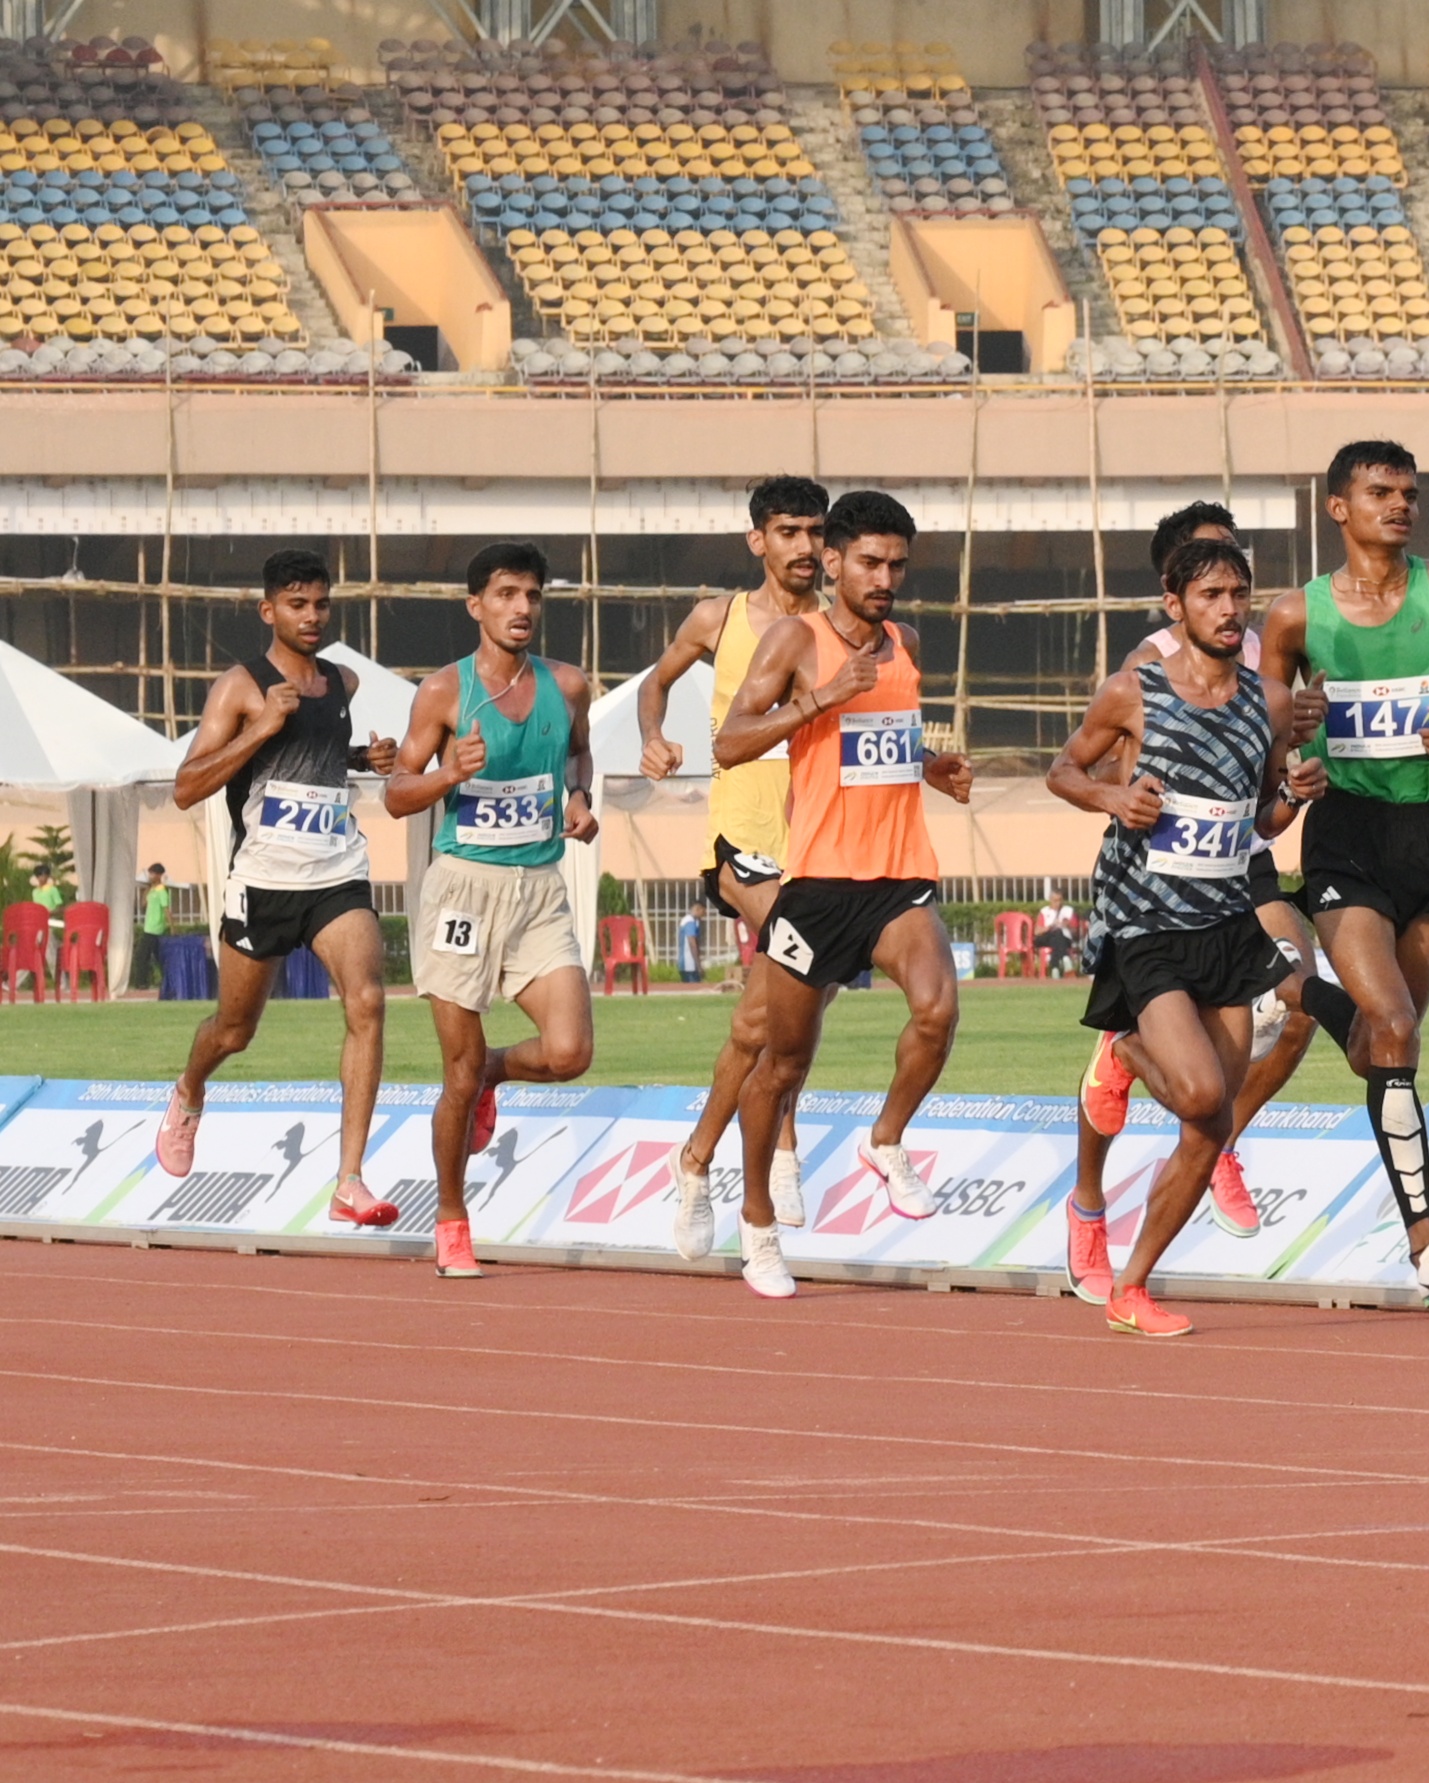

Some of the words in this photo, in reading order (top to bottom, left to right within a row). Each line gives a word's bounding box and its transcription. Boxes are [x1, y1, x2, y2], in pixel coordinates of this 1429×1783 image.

[1345, 698, 1422, 738] 147
[857, 729, 911, 766] 661
[275, 800, 334, 834] 270
[474, 795, 539, 829] 533
[1171, 817, 1240, 858] 341
[445, 919, 472, 947] 13
[919, 1096, 1017, 1121] Federation
[1249, 1105, 1347, 1130] harkhand
[147, 1171, 275, 1224] PUMA
[933, 1176, 1027, 1218] HSBC
